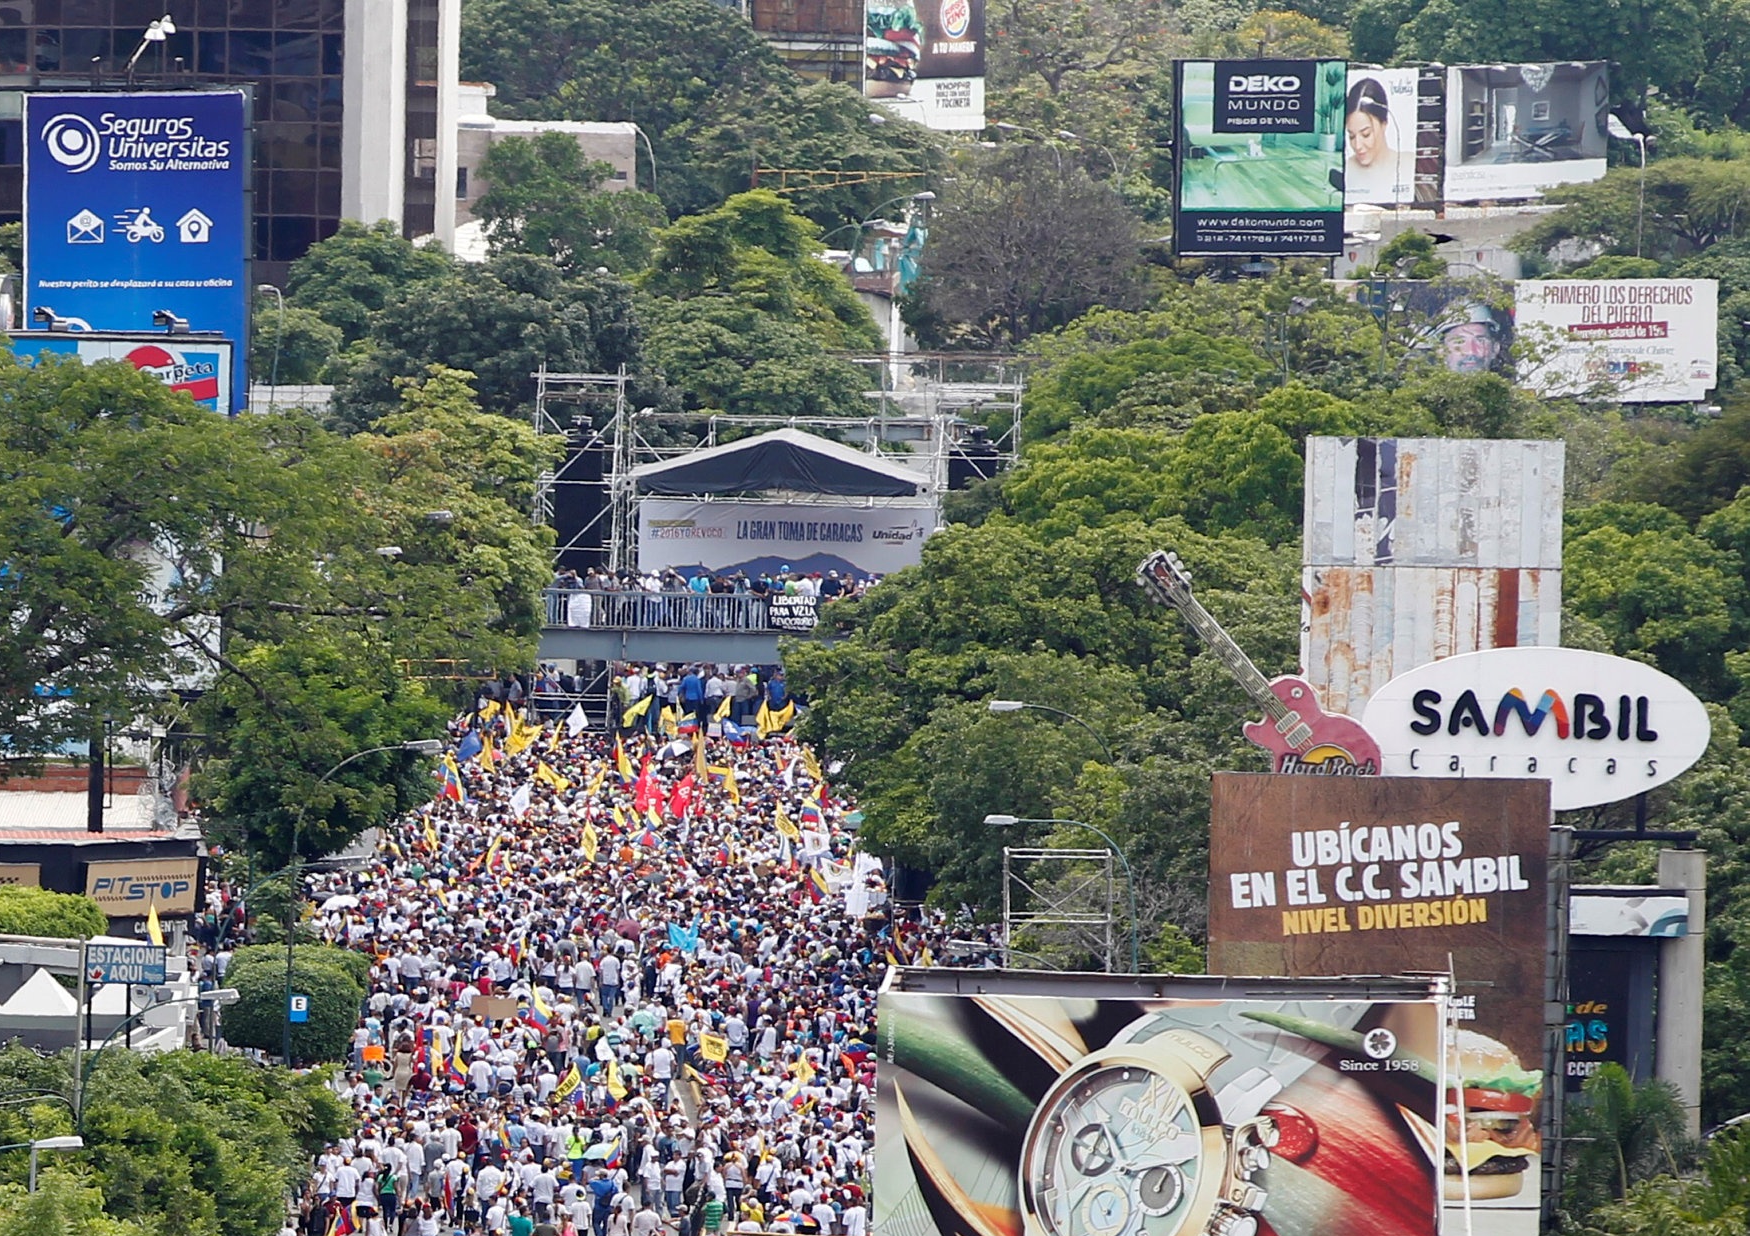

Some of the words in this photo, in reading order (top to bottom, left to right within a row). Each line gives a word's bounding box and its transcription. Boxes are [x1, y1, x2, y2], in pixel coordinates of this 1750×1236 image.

[1228, 75, 1301, 92] DEKO
[1228, 99, 1300, 111] MUNDO
[99, 112, 194, 142] Seguros
[108, 136, 230, 158] Universitas
[108, 159, 147, 171] Somos
[149, 159, 164, 171] Su
[165, 158, 229, 170] Alternativa
[1543, 285, 1600, 305] PRIMERO
[1603, 285, 1625, 305] LOS
[1628, 285, 1693, 305] DERECHOS
[1582, 305, 1602, 323] DEL
[1607, 305, 1653, 323] PUEBLO
[737, 521, 748, 540] LA
[750, 521, 776, 541] GRAN
[778, 521, 806, 541] TOMA
[807, 522, 818, 541] DE
[820, 522, 863, 542] CARACAS
[872, 529, 913, 540] Unidad
[1410, 687, 1658, 742] SAMBIL
[1280, 753, 1328, 775] Hard
[1328, 756, 1377, 776] Rock
[1410, 748, 1658, 777] Caracas
[1291, 822, 1463, 868] UBÍCANOS
[1230, 871, 1277, 908] EN
[1286, 869, 1327, 905] EL
[1336, 864, 1391, 901] C.C.
[1400, 855, 1529, 898] SAMBIL
[1282, 906, 1351, 936] NIVEL
[1357, 895, 1487, 931] DIVERSIÓN
[88, 946, 164, 966] ESTACIONE
[110, 965, 143, 982] AQUI
[295, 998, 303, 1011] E
[1575, 1001, 1608, 1015] de
[1339, 1059, 1379, 1071] Since
[1384, 1059, 1420, 1071] 1958
